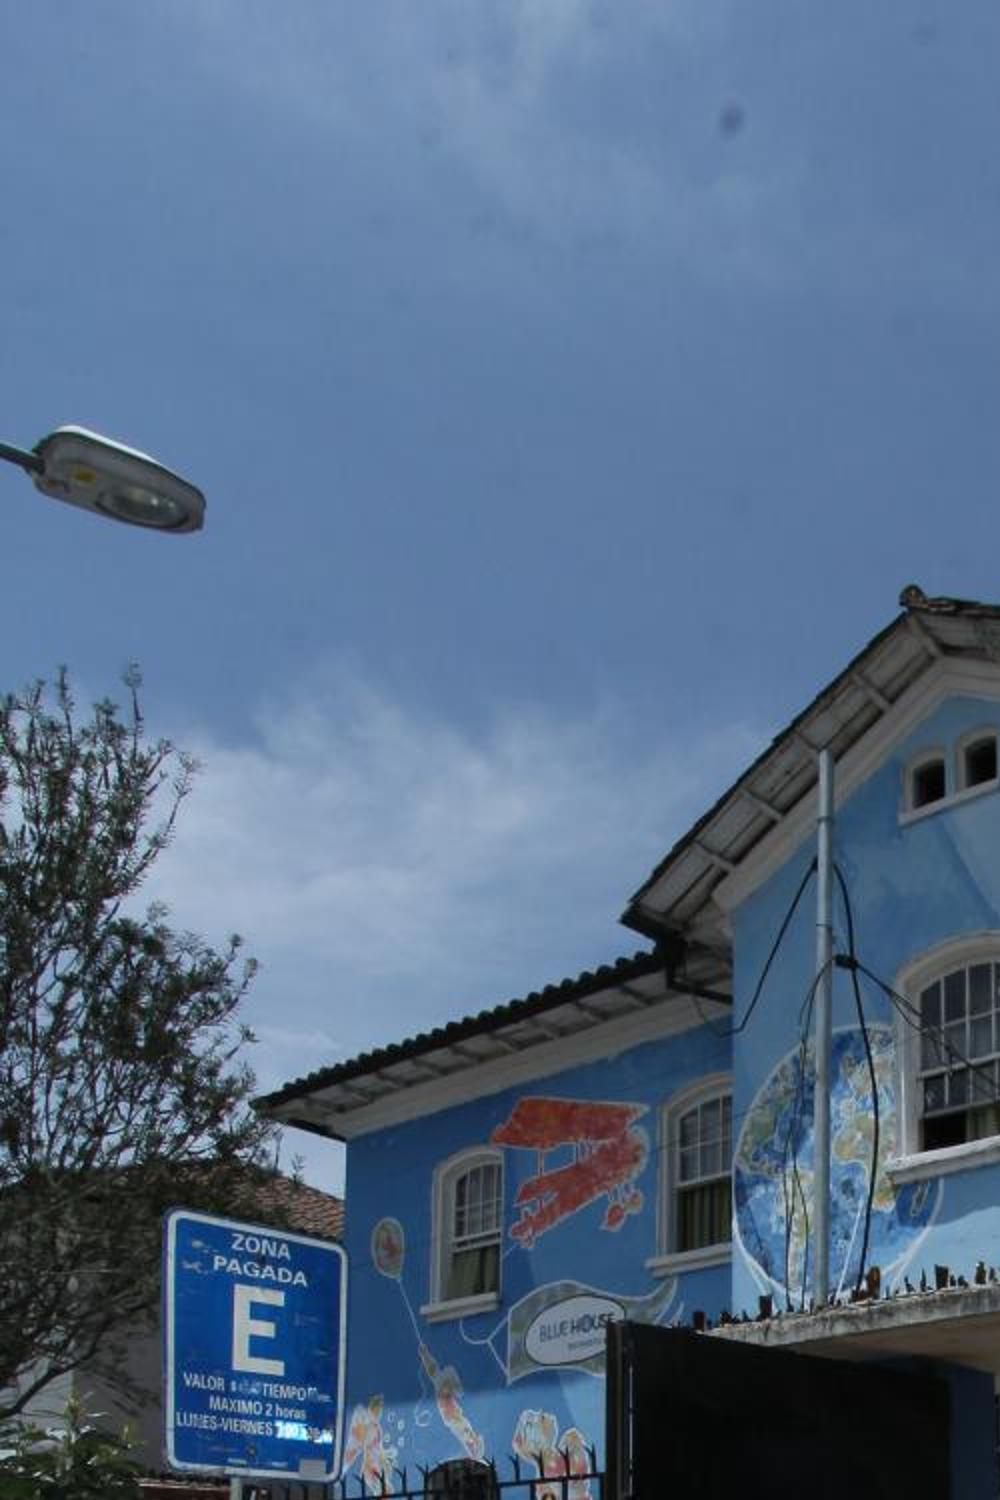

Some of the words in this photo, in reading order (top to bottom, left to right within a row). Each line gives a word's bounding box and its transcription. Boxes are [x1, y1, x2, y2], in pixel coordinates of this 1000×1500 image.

[231, 1233, 291, 1260] ZONA
[212, 1255, 308, 1288] PAGADA
[232, 1283, 285, 1376] E
[539, 1320, 567, 1342] BLUE
[183, 1372, 225, 1391] VALOR
[263, 1383, 306, 1402] TIEMPO
[209, 1394, 263, 1416] MAXIMO
[265, 1403, 273, 1417] 2
[275, 1404, 307, 1421] horas
